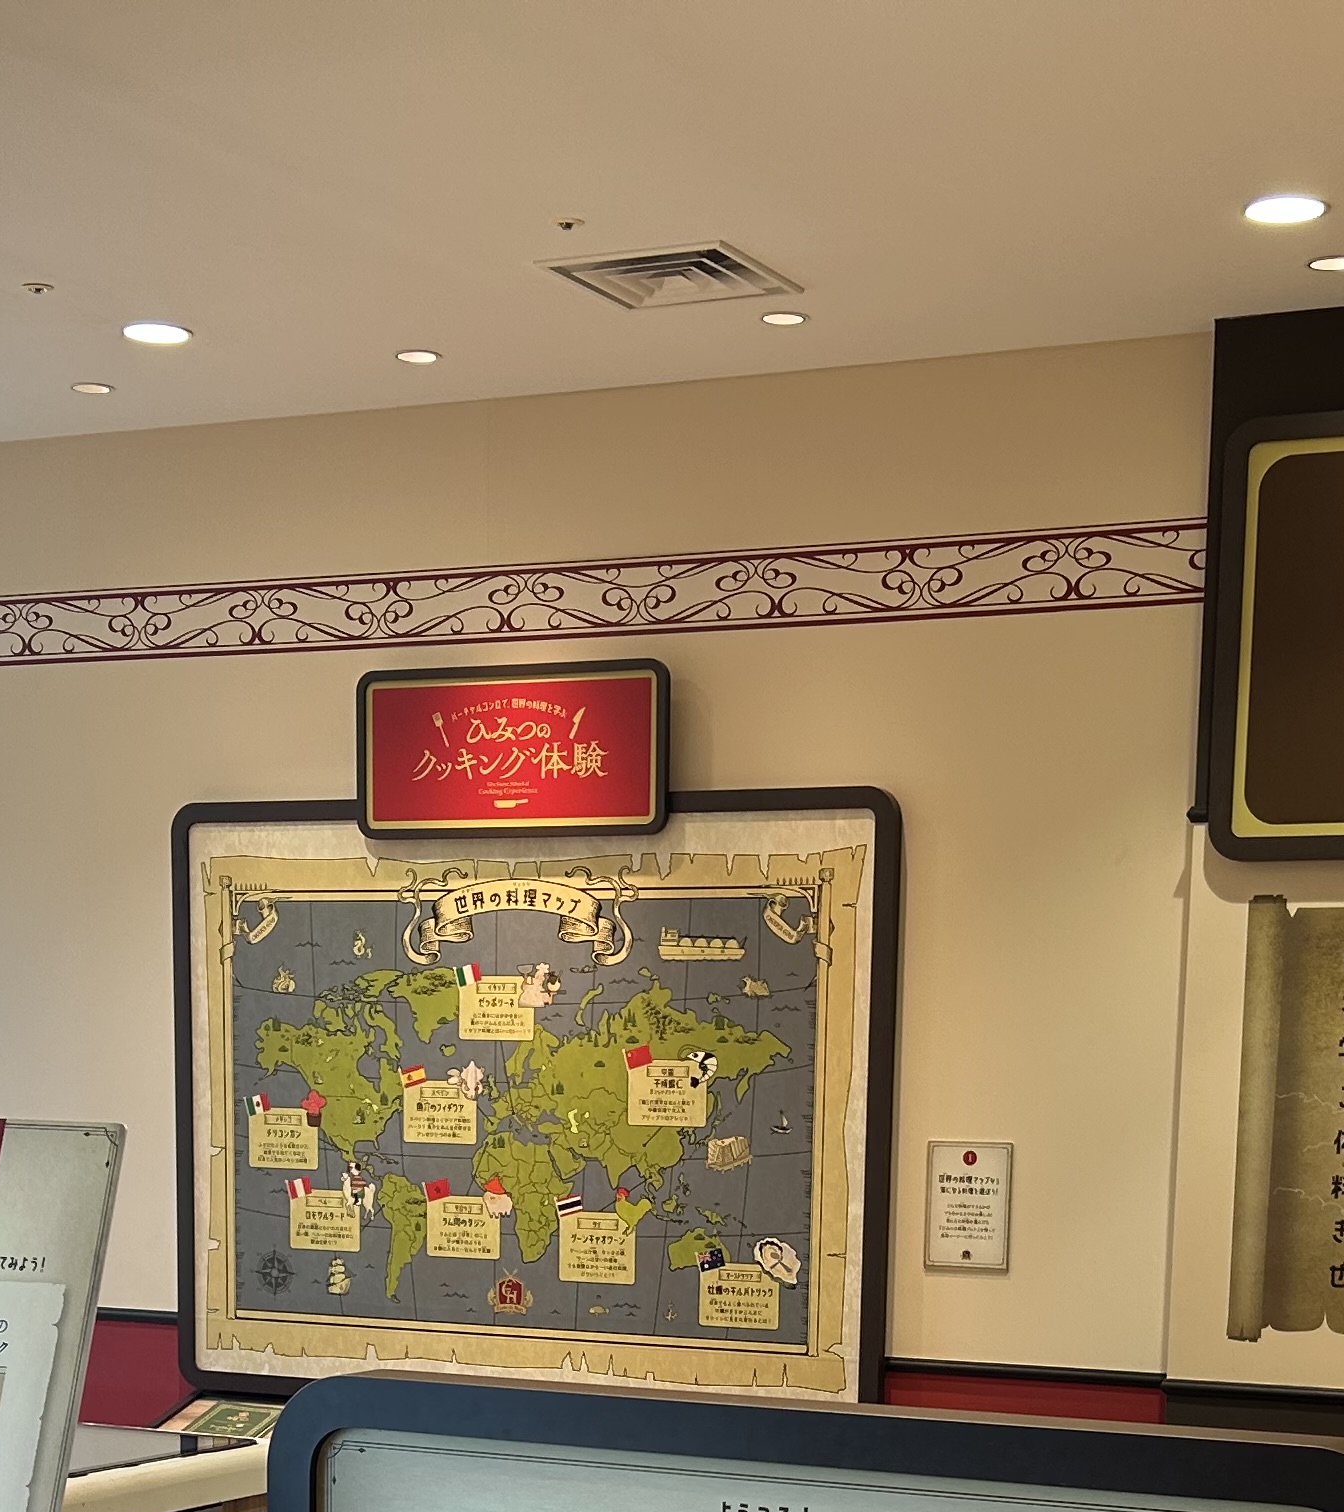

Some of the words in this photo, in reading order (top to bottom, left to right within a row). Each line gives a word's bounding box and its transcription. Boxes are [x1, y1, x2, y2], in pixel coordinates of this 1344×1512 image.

[465, 715, 552, 744] ひみつの
[411, 740, 609, 782] クッキング体験
[454, 888, 582, 914] 世界の料理マップ
